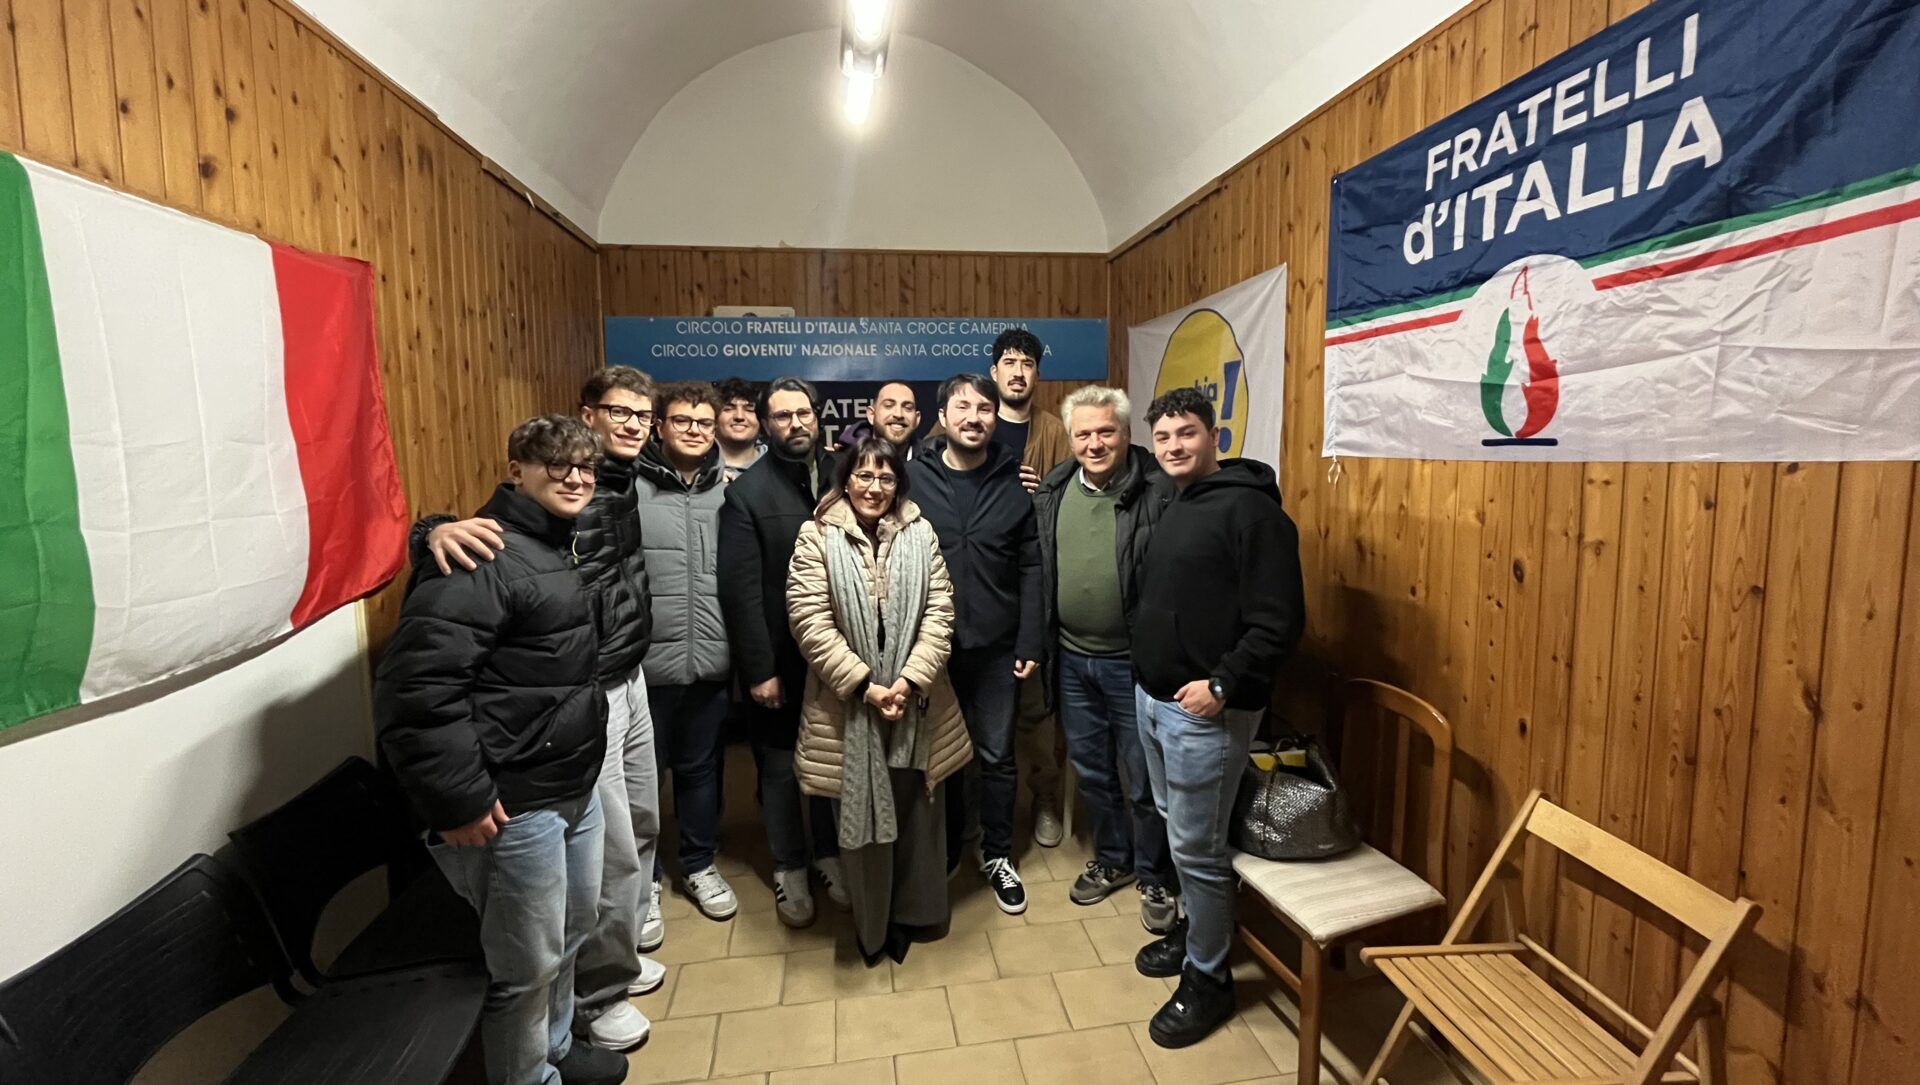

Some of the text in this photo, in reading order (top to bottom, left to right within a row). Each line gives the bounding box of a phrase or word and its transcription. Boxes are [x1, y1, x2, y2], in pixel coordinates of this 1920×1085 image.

[1425, 12, 1699, 192] FRATELLI
[1403, 95, 1723, 265] d'ITALIA
[651, 343, 719, 357] CIRCOLO
[722, 343, 797, 357] GIOVENTU'
[801, 343, 878, 357] NAZIONALE
[884, 343, 927, 357] SANTA
[931, 343, 979, 357] CROCE
[675, 321, 743, 335] CIRCOLO
[746, 321, 801, 335] FRATELLI
[805, 321, 858, 335] D'ITALIA
[862, 321, 903, 335] SANTA
[907, 321, 956, 335] CROCE
